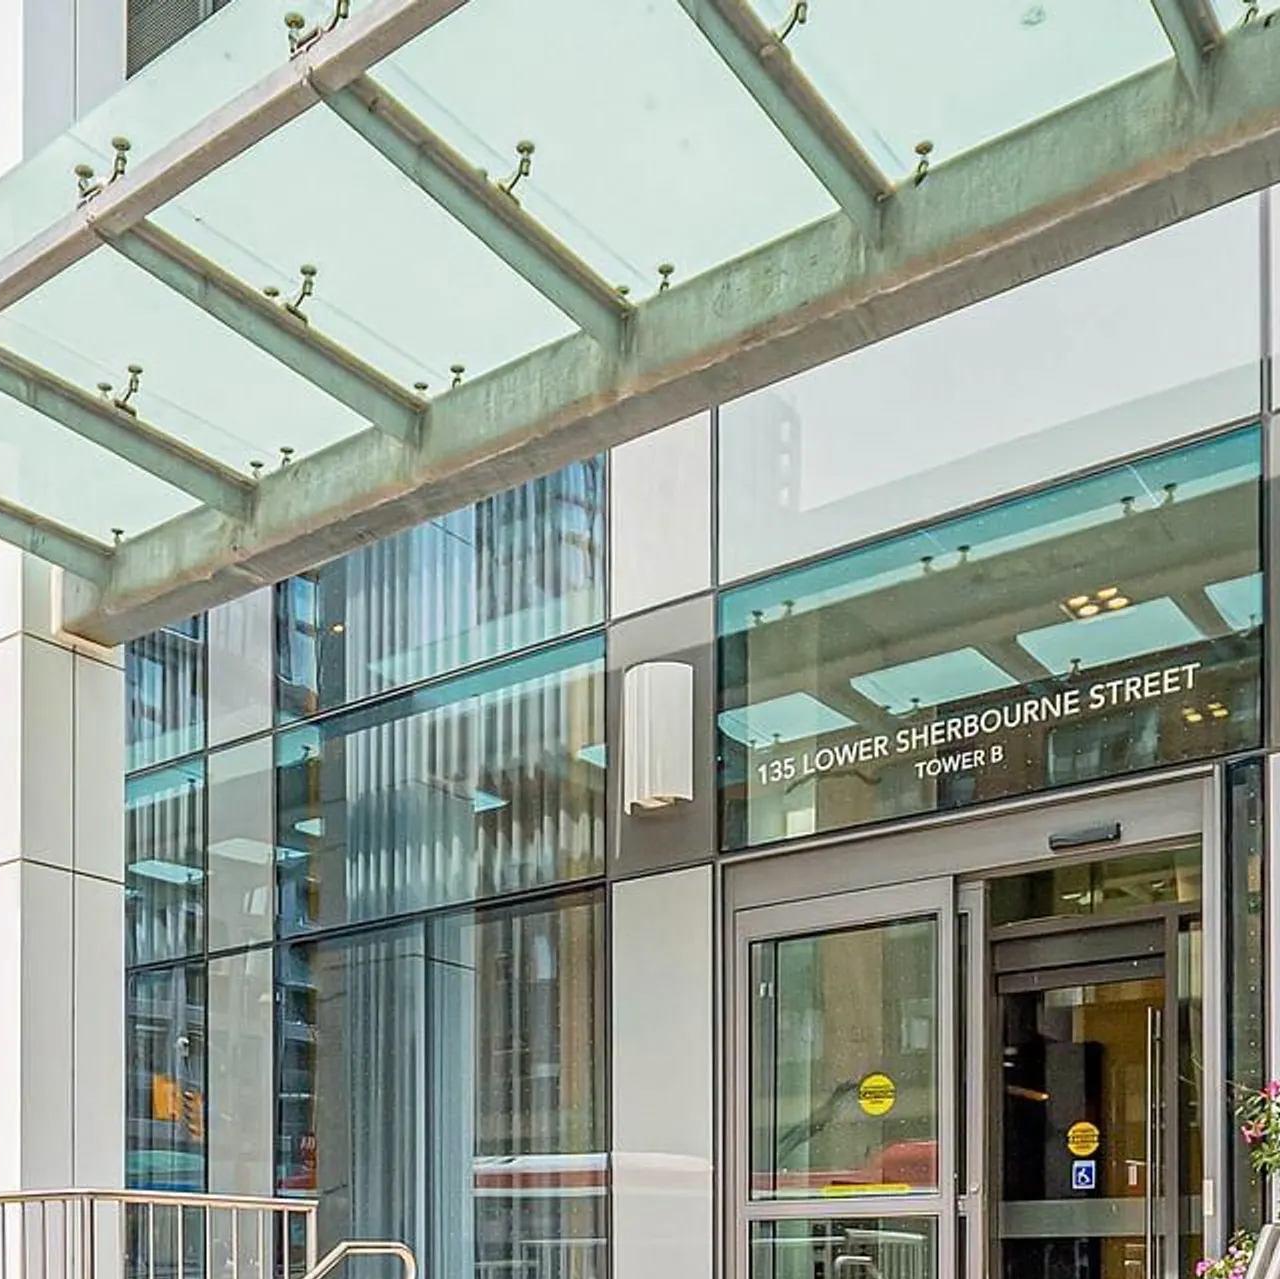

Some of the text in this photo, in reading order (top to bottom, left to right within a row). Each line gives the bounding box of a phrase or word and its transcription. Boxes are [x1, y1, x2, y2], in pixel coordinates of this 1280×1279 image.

[758, 662, 1201, 785] 135 LOWER SHERBOURNE STREET
[914, 745, 1004, 780] TOWER B
